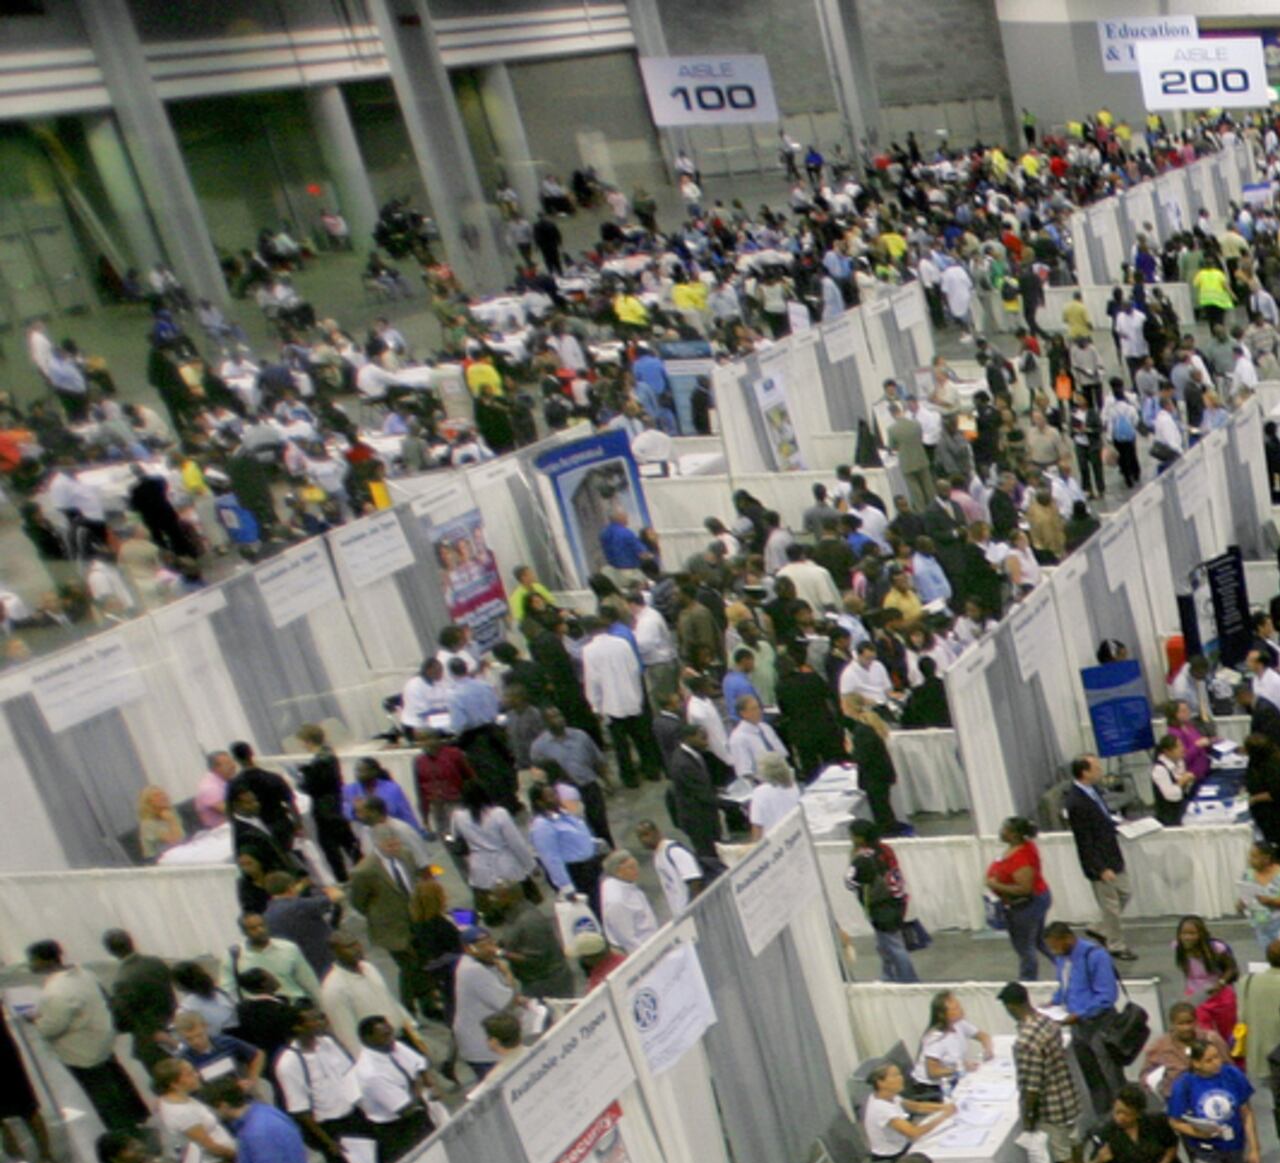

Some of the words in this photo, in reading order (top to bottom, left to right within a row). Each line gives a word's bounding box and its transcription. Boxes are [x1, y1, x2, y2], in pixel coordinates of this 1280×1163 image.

[1104, 21, 1191, 39] Education
[1159, 68, 1251, 95] 200
[669, 84, 757, 111] 100
